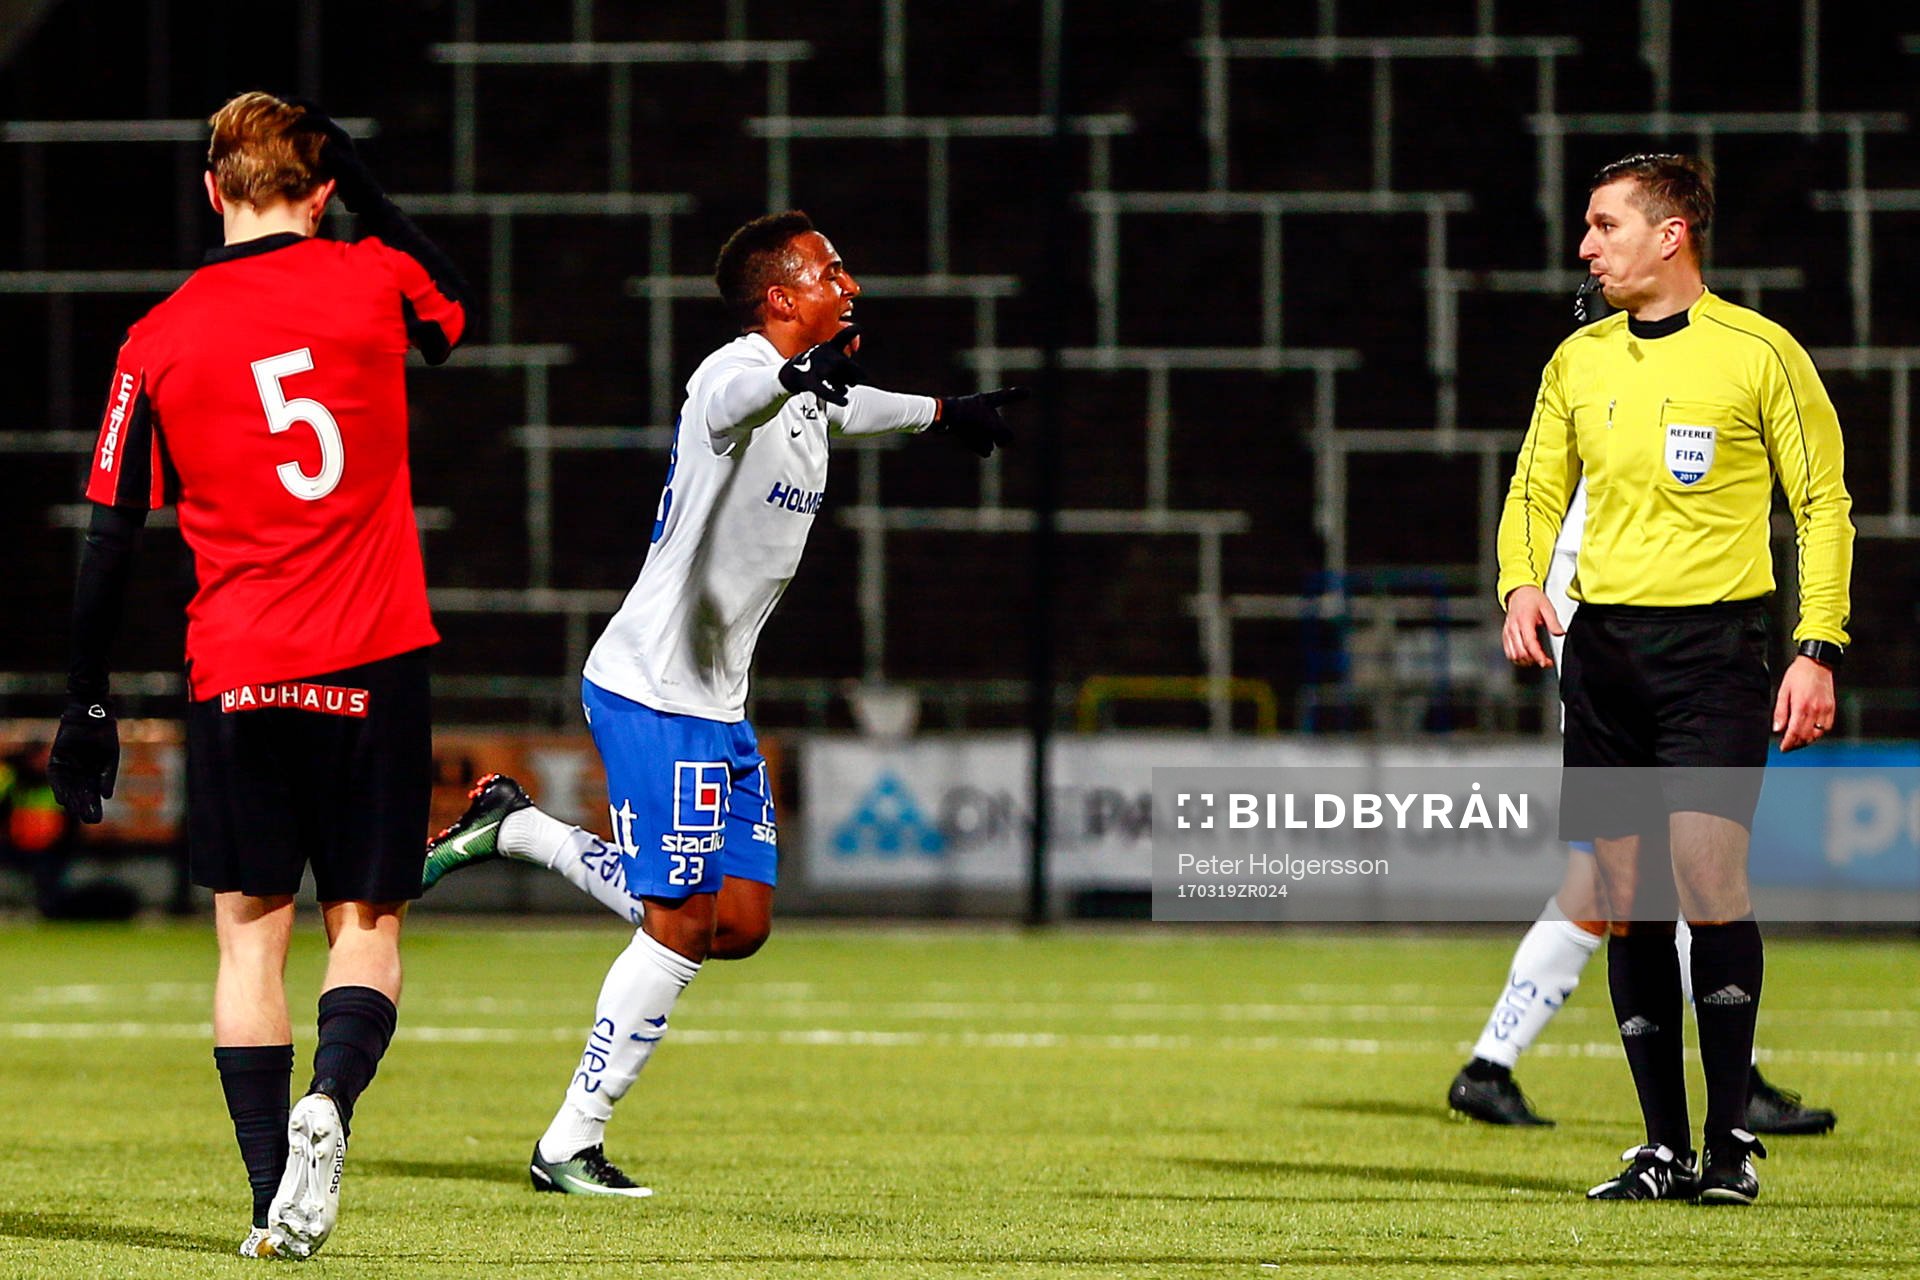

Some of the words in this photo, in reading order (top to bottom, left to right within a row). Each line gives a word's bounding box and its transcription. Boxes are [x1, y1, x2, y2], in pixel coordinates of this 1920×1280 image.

[99, 372, 134, 472] stadium
[250, 347, 345, 501] 5
[1670, 428, 1713, 440] REFEREE
[1676, 449, 1705, 462] FIFA
[1680, 473, 1698, 481] 2017
[224, 685, 365, 713] BAUHAUS
[668, 854, 705, 886] 23
